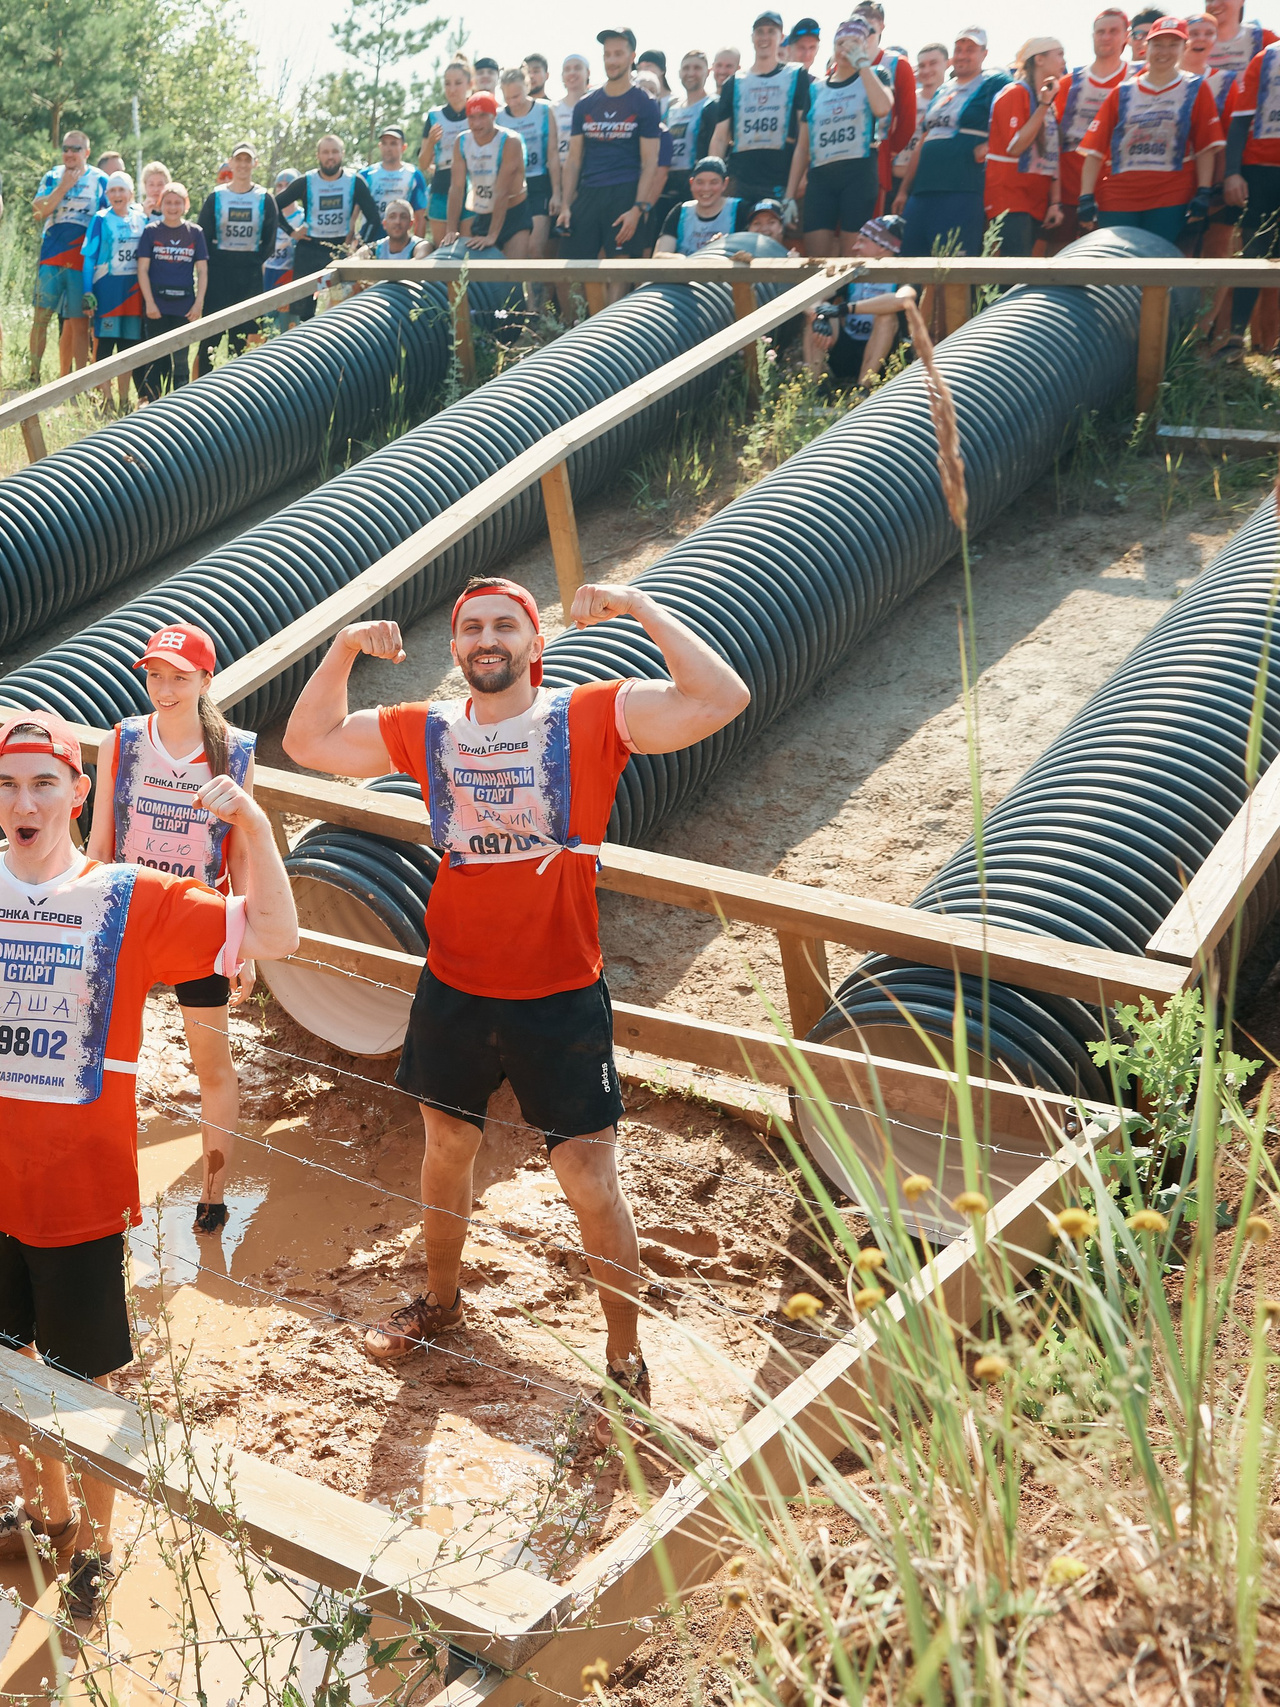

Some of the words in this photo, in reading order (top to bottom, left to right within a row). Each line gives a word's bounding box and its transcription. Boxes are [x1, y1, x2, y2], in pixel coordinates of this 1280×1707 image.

[743, 117, 778, 134] 5468
[820, 126, 856, 148] 5463
[317, 213, 344, 226] 5525
[225, 225, 254, 238] 5520
[458, 743, 487, 755] ГОНКА
[488, 741, 529, 752] ГЕРОЕВ
[144, 775, 173, 788] ГОНКА
[176, 782, 202, 791] ГЕРО
[455, 767, 533, 788] КОМАНДНЫЙ
[476, 788, 511, 803] СТАРТ
[137, 799, 208, 822] КОМАНДНЫЙ
[154, 817, 187, 833] СТАРТ
[33, 910, 83, 925] ГЕРОЕВ
[7, 964, 53, 982] СТАРТ
[601, 1062, 611, 1093] adidas
